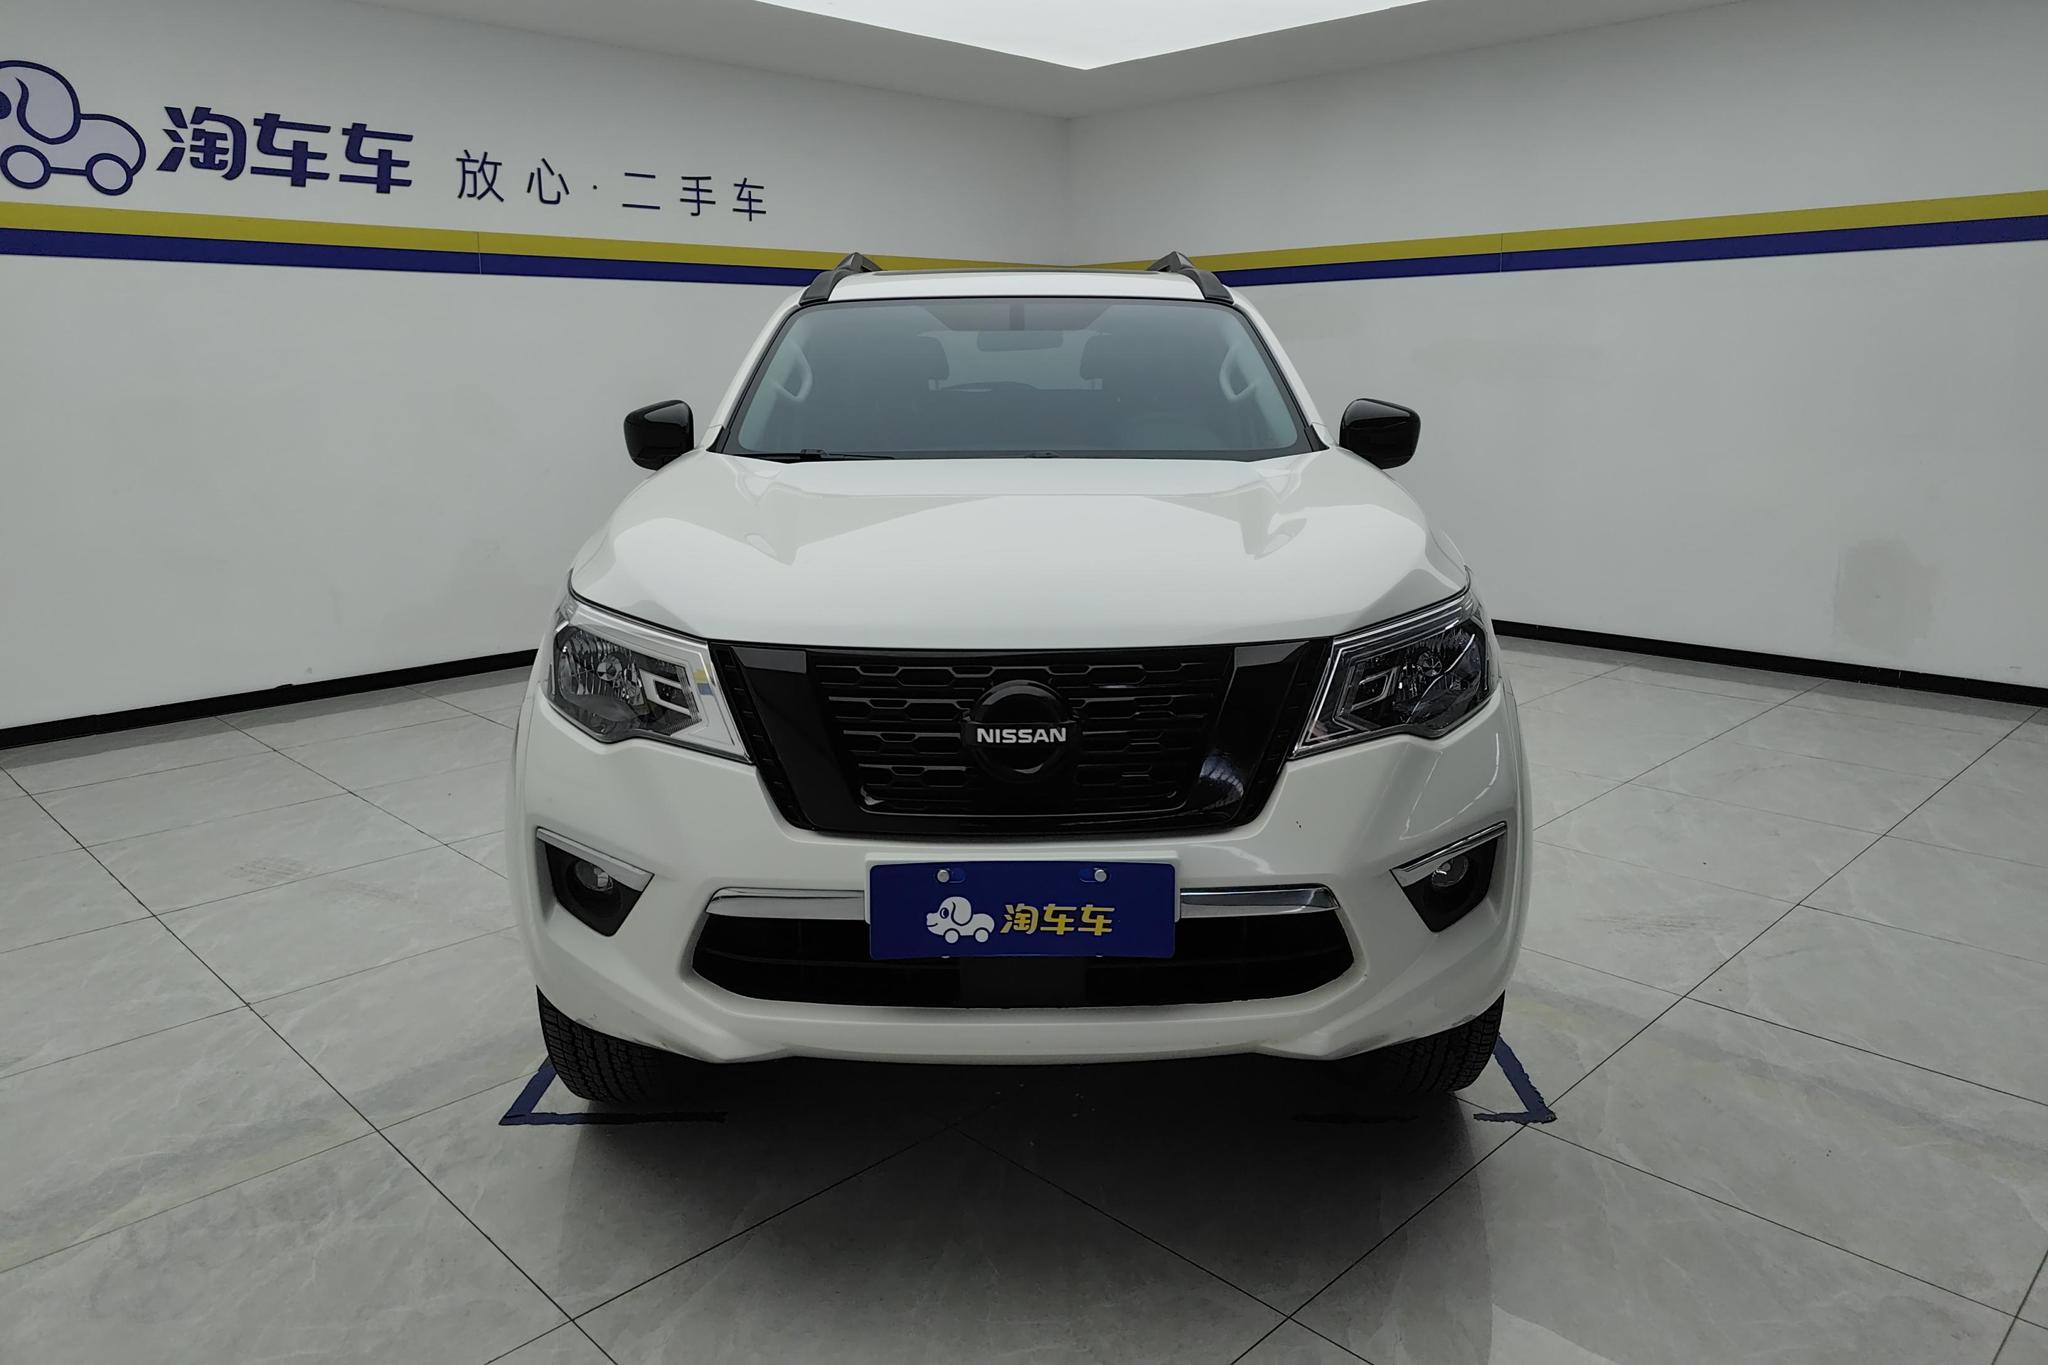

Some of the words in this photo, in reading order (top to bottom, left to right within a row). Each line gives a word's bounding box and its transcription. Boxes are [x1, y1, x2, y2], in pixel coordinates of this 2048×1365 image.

[156, 106, 414, 194] 淘车车
[976, 727, 1067, 744] NISSAN
[1000, 903, 1116, 936] 淘车车
